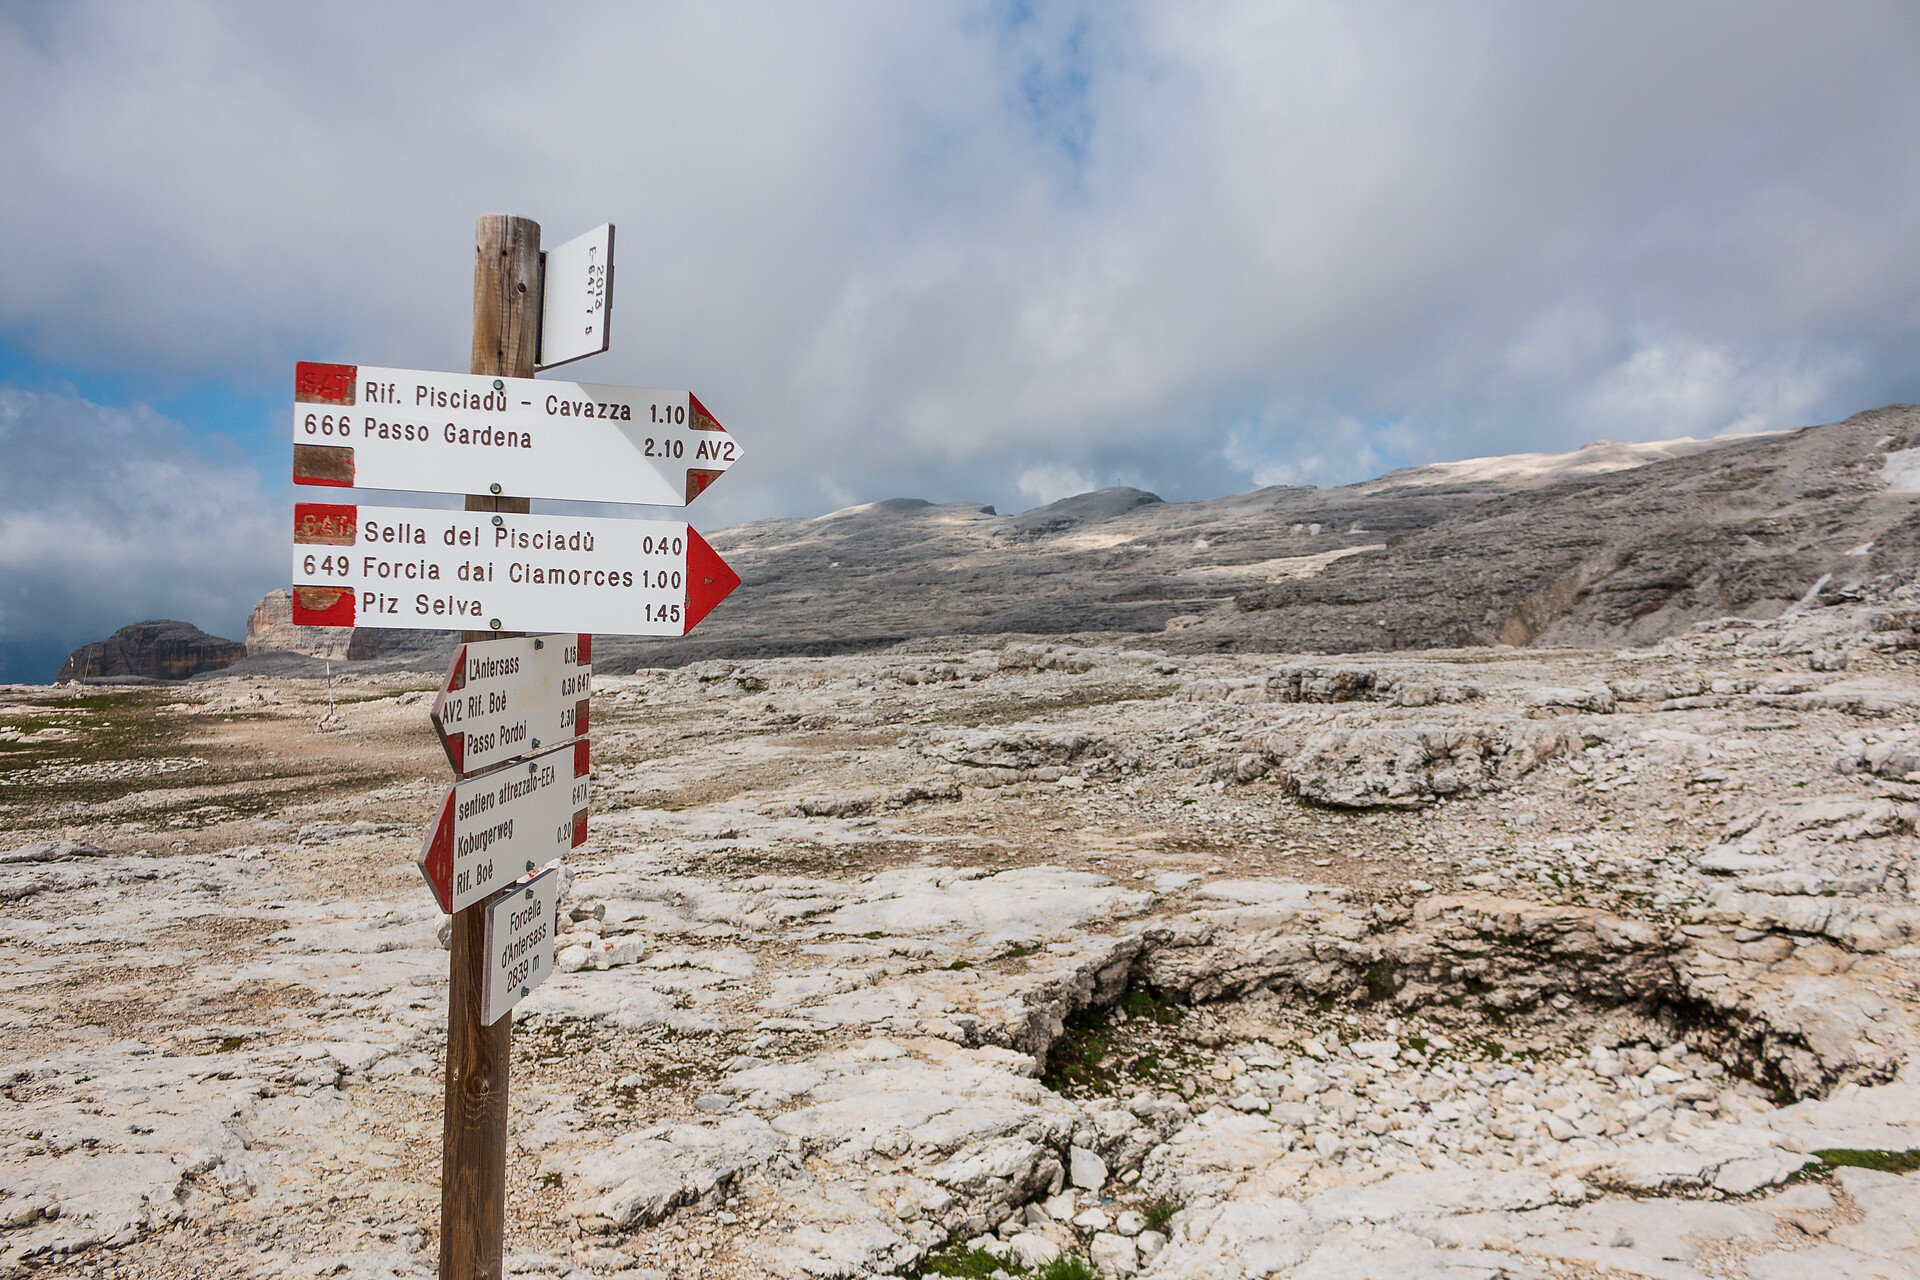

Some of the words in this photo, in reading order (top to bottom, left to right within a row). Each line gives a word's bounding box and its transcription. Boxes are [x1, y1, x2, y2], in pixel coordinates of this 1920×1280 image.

[300, 372, 349, 400] SAT
[366, 381, 401, 404] Rif.
[416, 385, 507, 412] Pisciadù
[545, 395, 631, 421] Cavazza
[650, 404, 685, 425] 1.10
[305, 413, 351, 437] 666
[365, 417, 429, 442] Passo
[444, 423, 532, 448] Gardena
[644, 438, 684, 459] 2.10
[696, 440, 736, 462] AV2
[300, 514, 349, 536] SAT
[364, 521, 426, 544] Sella
[443, 525, 479, 547] del
[495, 527, 594, 552] Pisciadù
[643, 536, 682, 556] 0.40
[303, 554, 350, 577] 649
[363, 556, 440, 580] Forcia
[457, 560, 493, 582] dai
[509, 563, 633, 587] Ciamorces
[642, 570, 681, 589] 1.00
[363, 592, 399, 614] Piz
[415, 594, 483, 616] Selva
[645, 604, 680, 623] 1.45
[469, 656, 520, 681] L'Antersass
[564, 646, 577, 665] 0.15
[442, 698, 463, 725] AV2
[468, 694, 484, 719] Rif.
[489, 690, 507, 716] Boè
[561, 679, 576, 696] 0.30
[577, 672, 590, 693] 647
[467, 732, 495, 756] Passo
[500, 720, 527, 746] Pordoi
[560, 708, 575, 728] 2.30
[458, 791, 495, 821] sentiero
[499, 765, 556, 805] attrezzato-EEA
[457, 819, 514, 859] Koburgerweg
[572, 782, 588, 805] 647A
[456, 869, 472, 896] Rif.
[556, 821, 572, 844] 0.20
[509, 898, 542, 935] Forcella
[501, 922, 547, 969] d'Antersass
[506, 958, 529, 994] 2839
[532, 954, 540, 973] m
